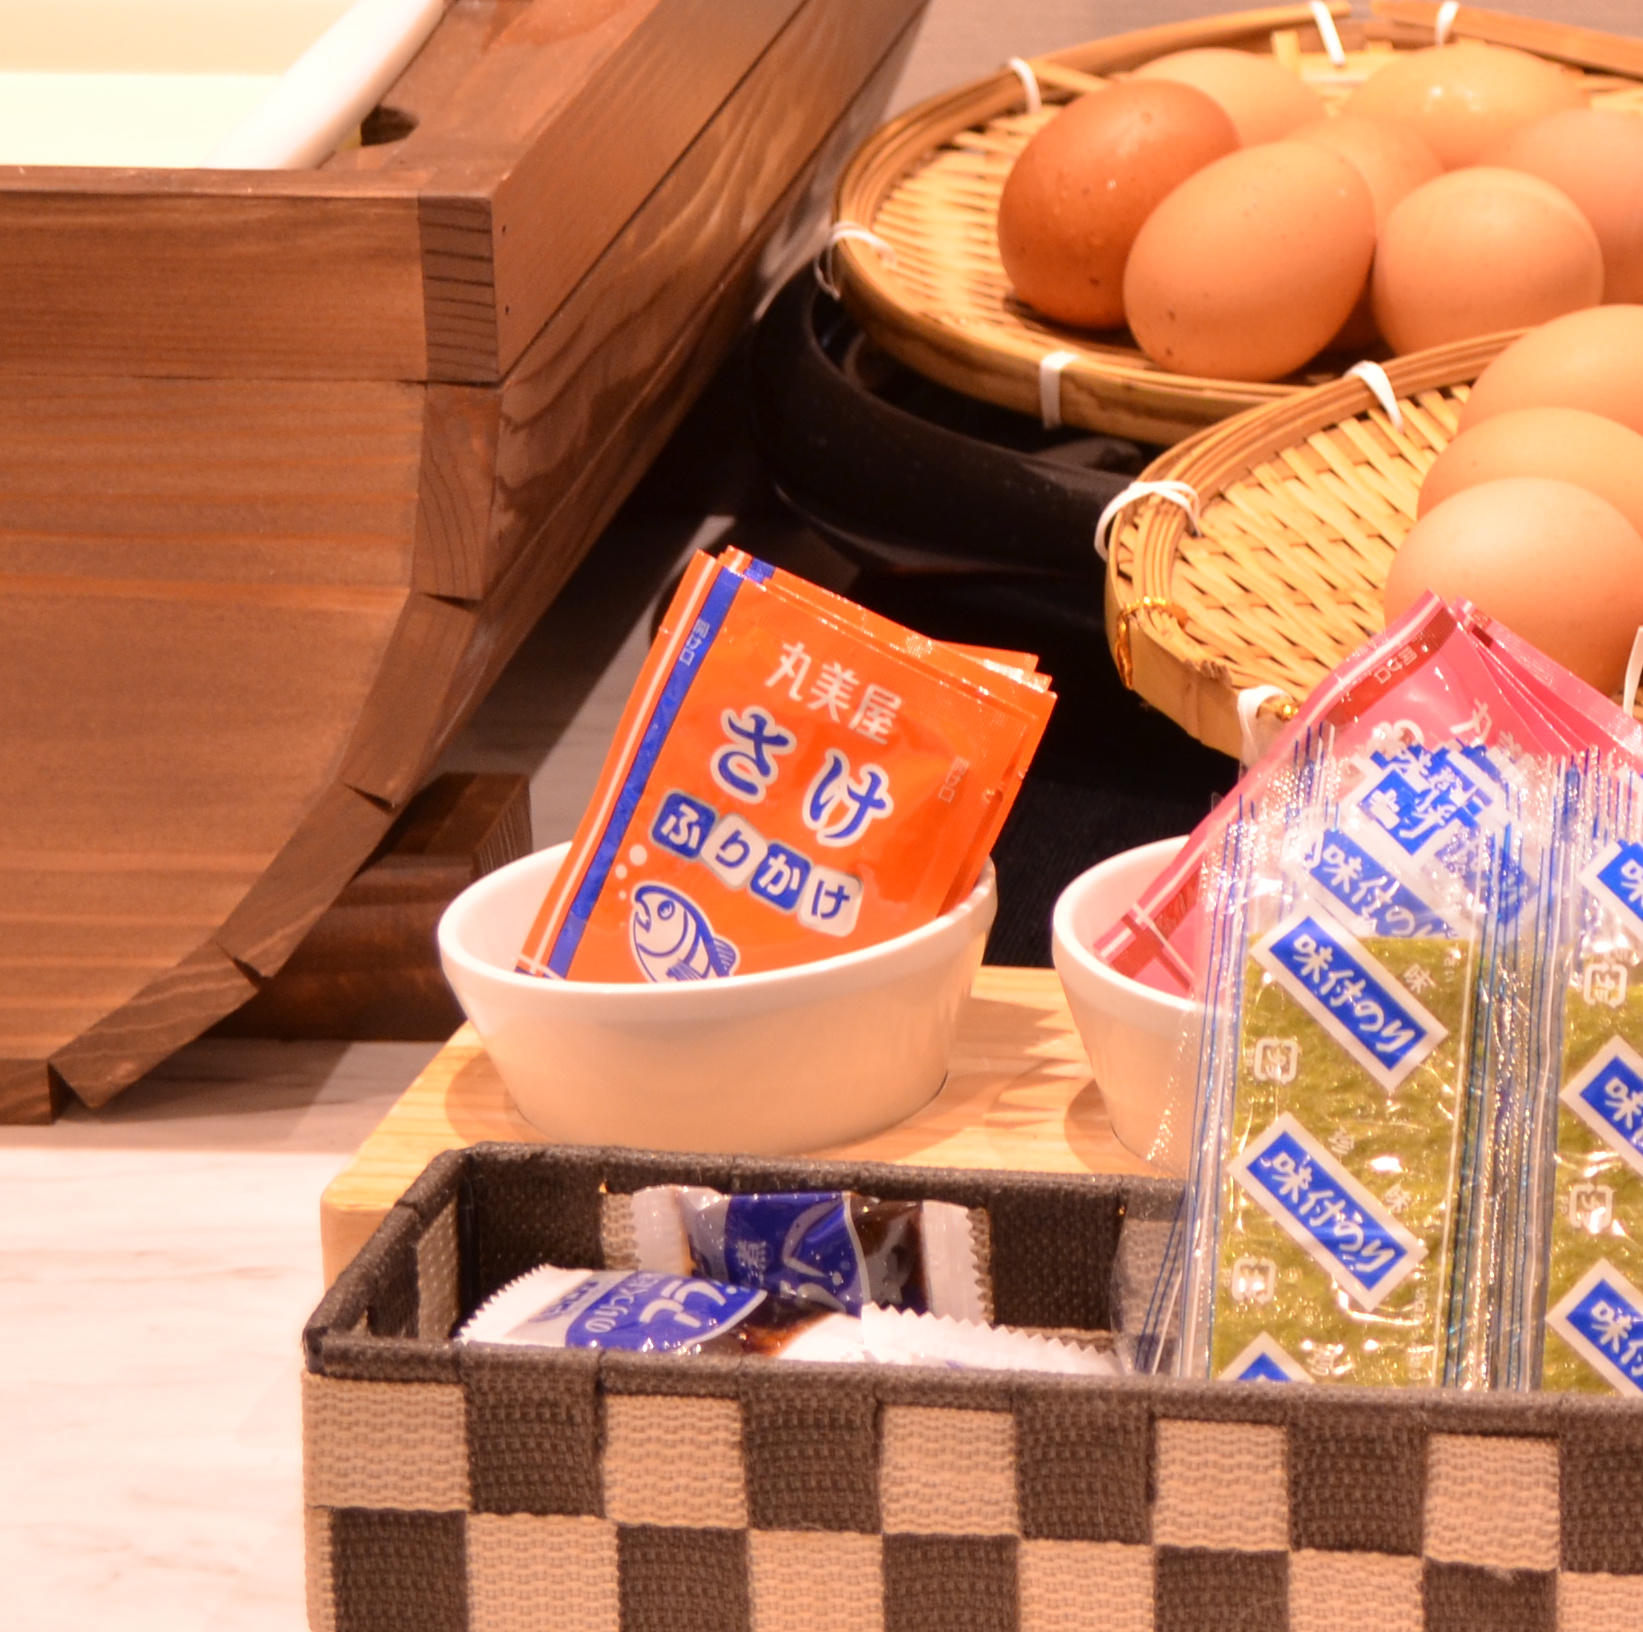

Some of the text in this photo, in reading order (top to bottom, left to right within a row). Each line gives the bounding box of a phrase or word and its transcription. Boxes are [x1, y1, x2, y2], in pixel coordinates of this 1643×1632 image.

[764, 641, 903, 746] 丸美屋
[711, 706, 894, 848] さけ
[656, 797, 856, 928] ふりかけ
[1292, 933, 1416, 1053] 味付のり
[1271, 1151, 1396, 1273] 味付のり
